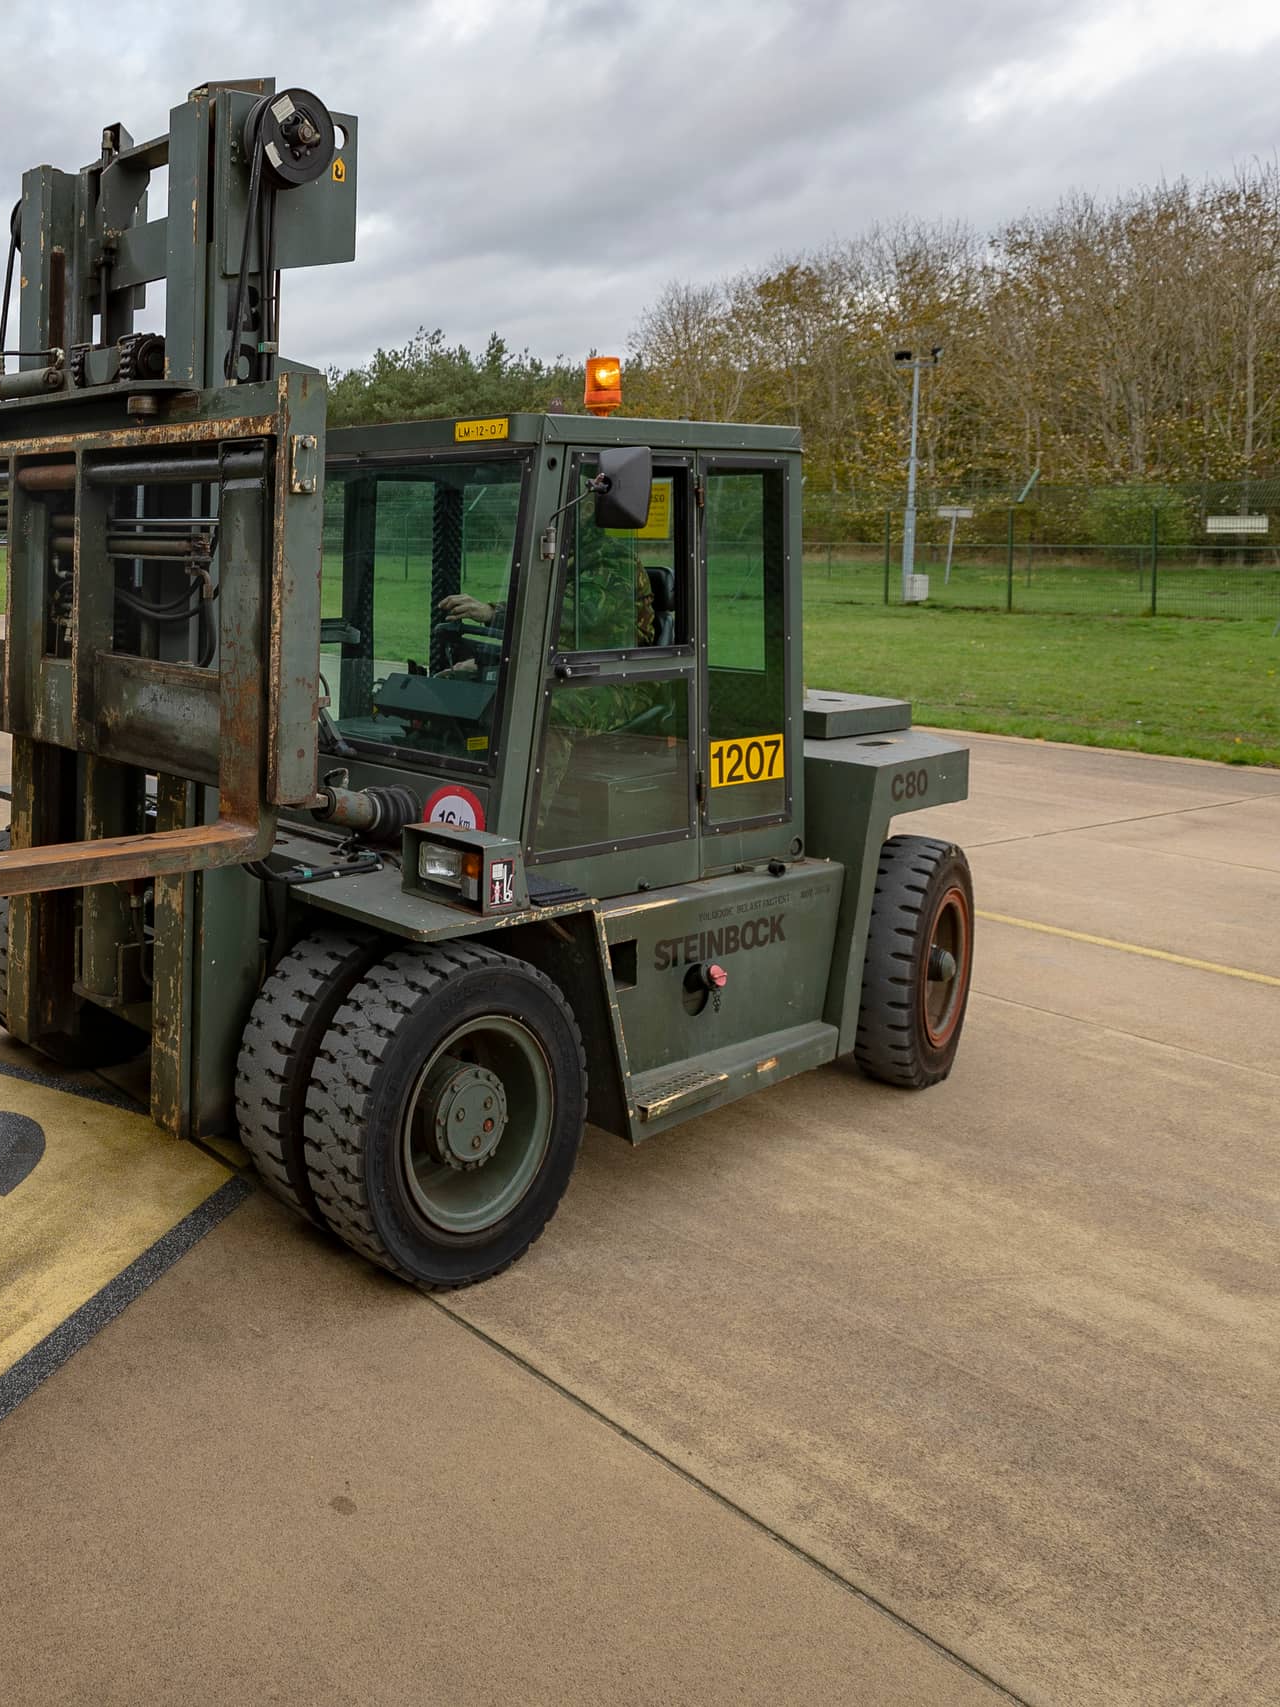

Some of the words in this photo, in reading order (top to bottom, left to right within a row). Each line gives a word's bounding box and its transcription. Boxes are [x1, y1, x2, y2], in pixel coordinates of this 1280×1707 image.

[458, 423, 504, 438] LM-12-07
[711, 740, 781, 785] 1207
[891, 769, 928, 802] C80
[654, 913, 786, 971] STEINBOCK
